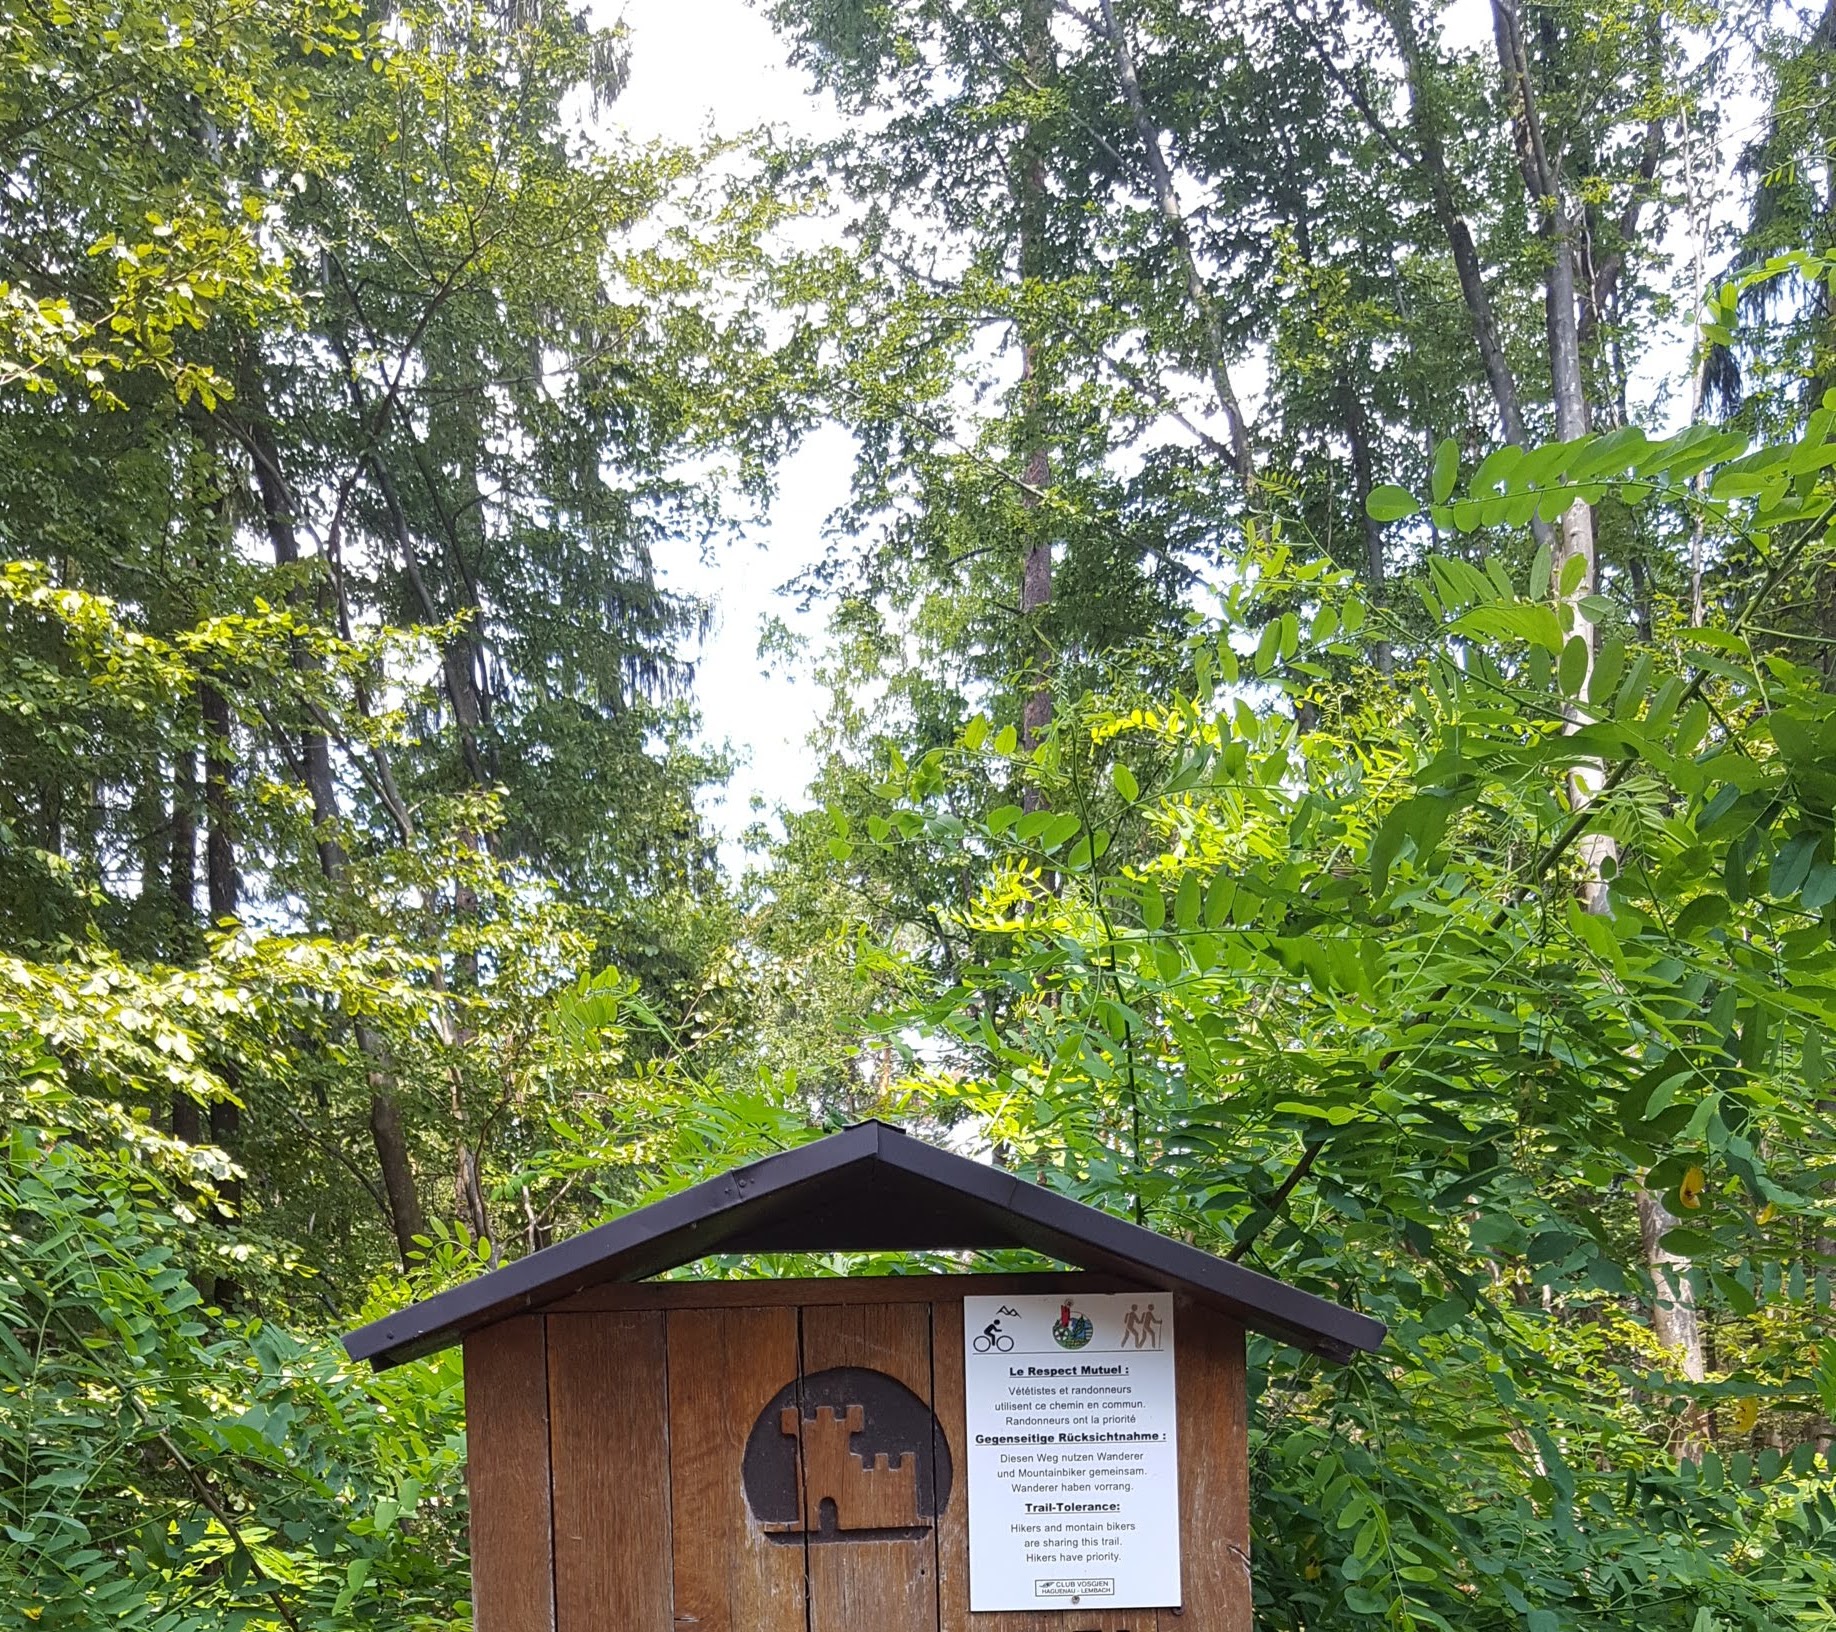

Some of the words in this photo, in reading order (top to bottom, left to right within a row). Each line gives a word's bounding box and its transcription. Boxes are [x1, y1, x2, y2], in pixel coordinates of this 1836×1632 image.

[1010, 1367, 1024, 1376] Le
[1028, 1366, 1077, 1377] Respect
[1081, 1366, 1121, 1375] Mutuel
[1009, 1386, 1056, 1396] Vététistes
[1072, 1386, 1132, 1394] randonneurs
[995, 1401, 1032, 1411] utilisent
[1050, 1401, 1084, 1410] chemin
[1102, 1401, 1146, 1409] commun.
[1006, 1416, 1069, 1425] Randonneurs
[1073, 1416, 1088, 1424] ont
[1091, 1416, 1099, 1424] la
[1103, 1414, 1136, 1426] priorité
[976, 1434, 1054, 1445] Gegenseitige
[1059, 1432, 1159, 1442] Rücksichtnahme
[1001, 1454, 1033, 1463] Diesen
[1037, 1453, 1058, 1464] Weg
[1062, 1453, 1094, 1461] nutzen
[1097, 1452, 1143, 1461] Wanderer
[998, 1469, 1014, 1478] und
[1018, 1468, 1086, 1477] Mountainbiker
[1089, 1467, 1147, 1478] gemeinsam.
[1012, 1483, 1058, 1492] Wanderer
[1062, 1482, 1091, 1491] haben
[1095, 1483, 1134, 1493] vorrang.
[1025, 1502, 1120, 1512] Trail-Tolerance:
[1011, 1523, 1041, 1533] Hikers
[1045, 1523, 1062, 1532] and
[1065, 1523, 1103, 1531] montain
[1107, 1522, 1135, 1531] bikers
[1025, 1539, 1039, 1547] are
[1043, 1538, 1078, 1548] sharing
[1081, 1537, 1098, 1546] this
[1102, 1537, 1122, 1546] trail.
[1026, 1553, 1056, 1562] Hikers
[1060, 1553, 1083, 1561] have
[1086, 1552, 1121, 1563] priority.
